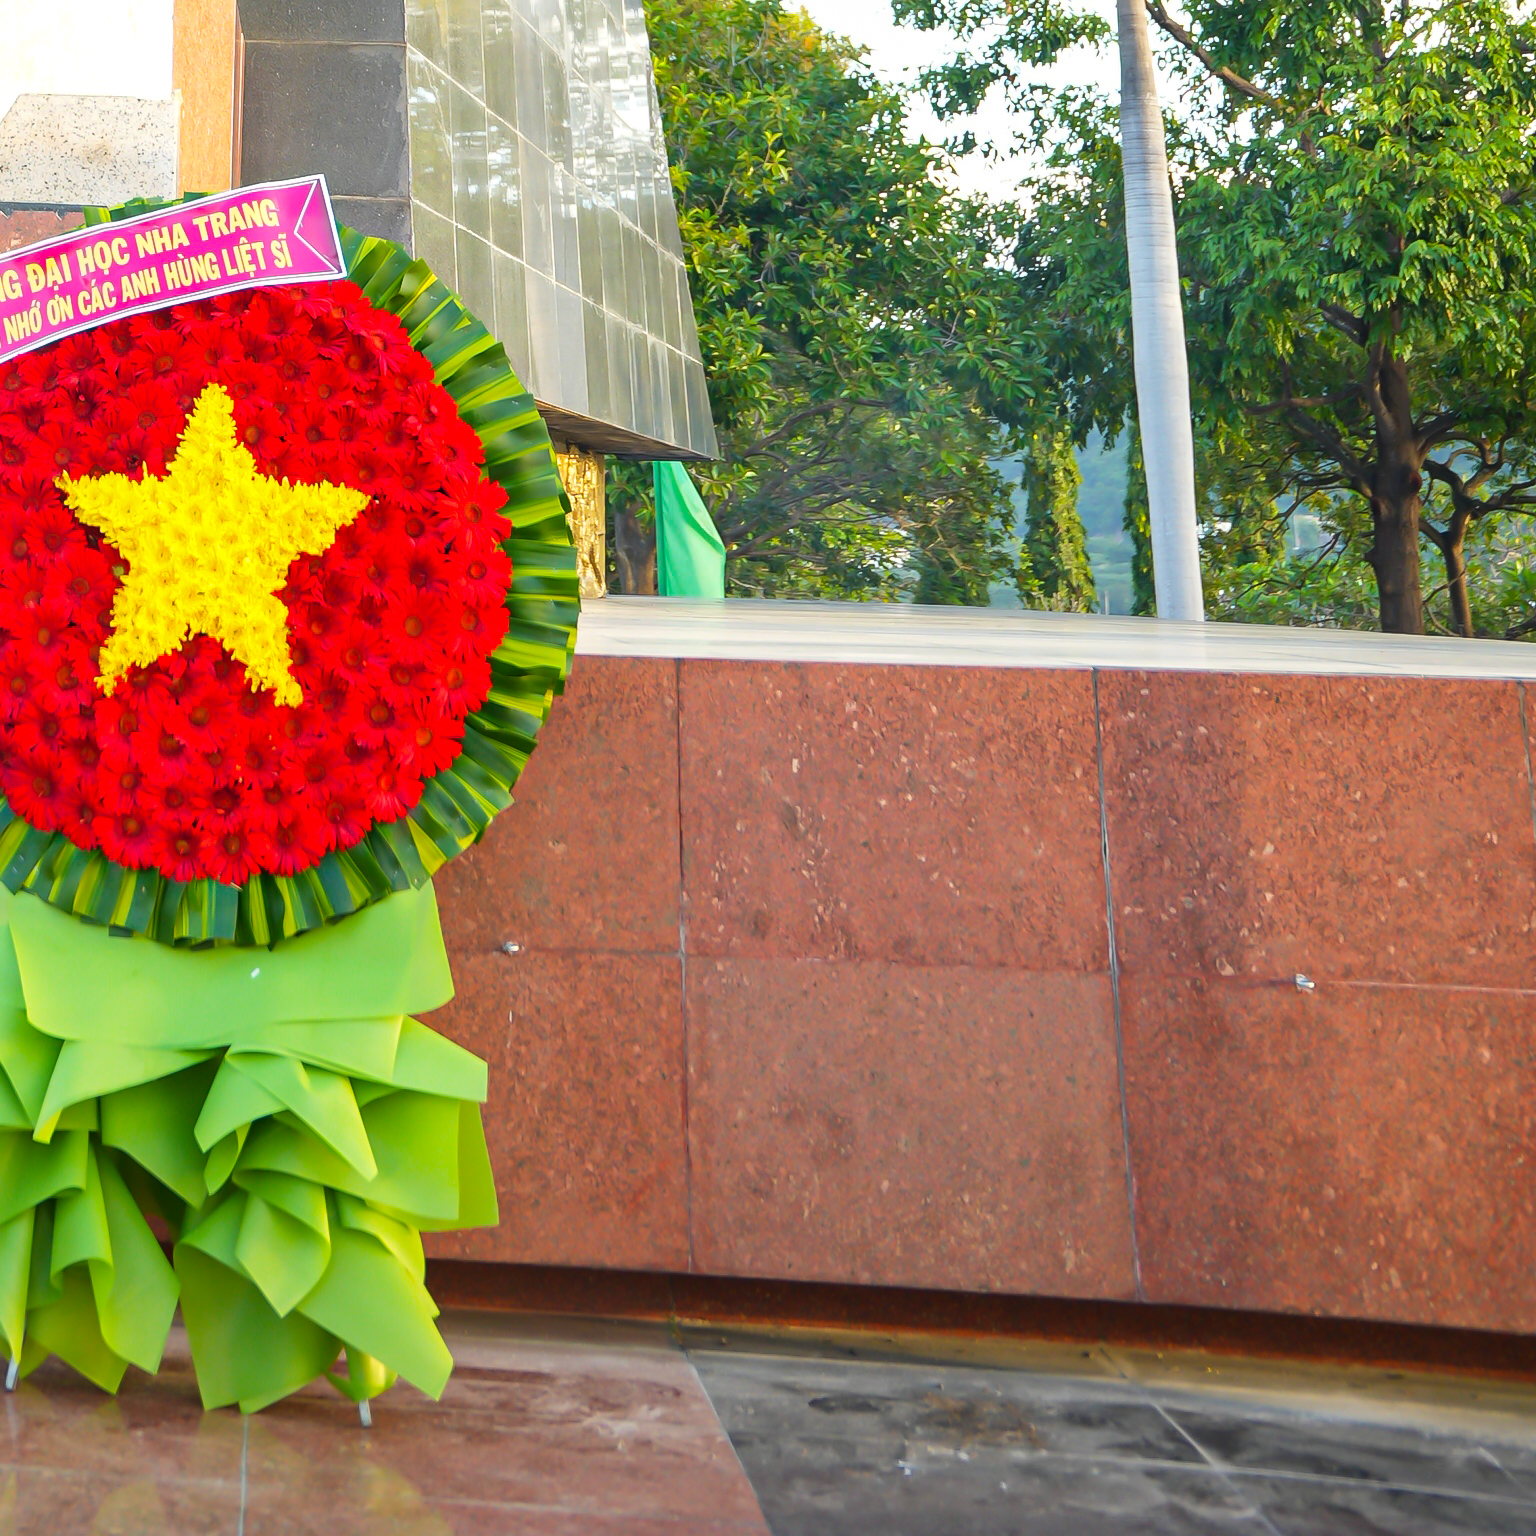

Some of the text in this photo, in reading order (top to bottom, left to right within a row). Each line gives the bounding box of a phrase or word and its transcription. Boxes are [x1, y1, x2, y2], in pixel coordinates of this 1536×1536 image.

[3, 299, 43, 345] NHỚ
[46, 293, 74, 326] ƠN
[77, 279, 116, 316] CÁC
[120, 266, 161, 303] ANH
[163, 252, 221, 291] HÙNG
[222, 236, 266, 277] LIỆT
[270, 232, 293, 268] SĨ
[25, 253, 72, 293] ĐẠI
[76, 237, 130, 276] HỌC
[135, 223, 190, 259] NHA
[193, 198, 280, 241] TRANG
